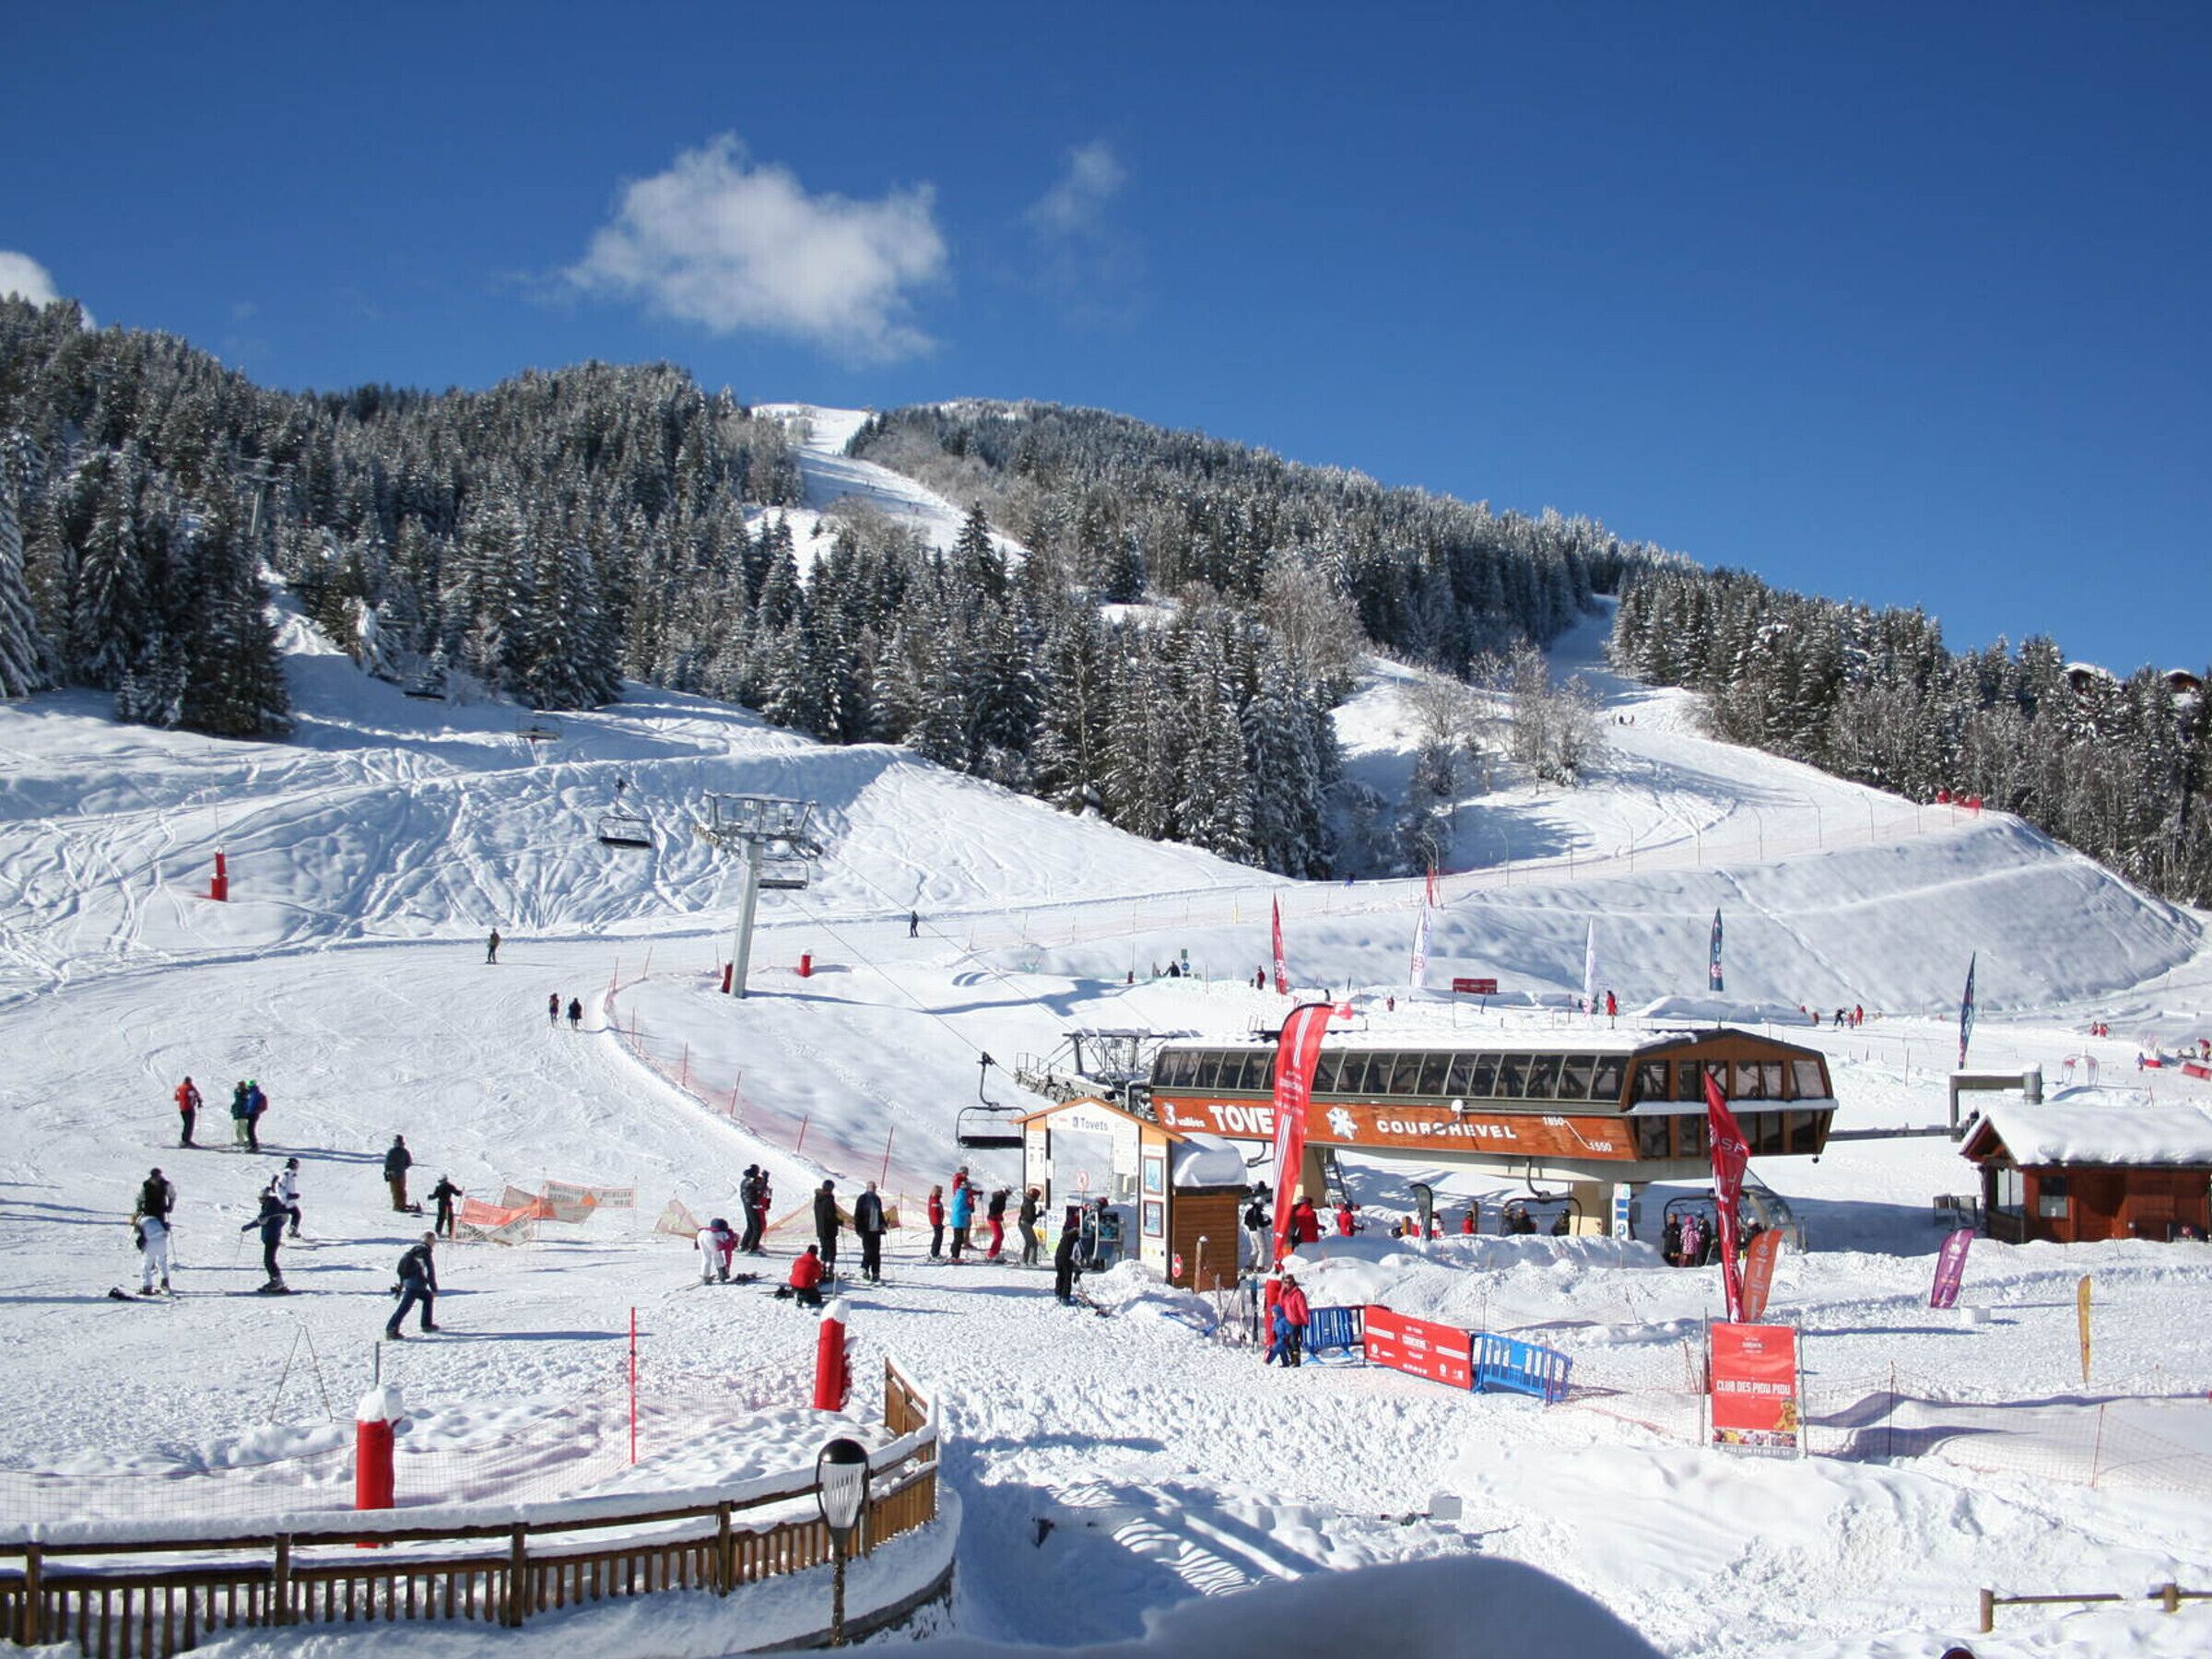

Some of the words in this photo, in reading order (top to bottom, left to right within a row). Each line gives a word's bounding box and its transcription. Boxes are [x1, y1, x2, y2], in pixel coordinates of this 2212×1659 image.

[1080, 1117, 1109, 1131] Tovets
[1208, 1104, 1307, 1135] TOVE
[1376, 1120, 1517, 1139] COURCHEVEL
[1588, 1140, 1613, 1153] 1550
[1716, 1380, 1735, 1391] CLUB
[1736, 1381, 1752, 1393] DES
